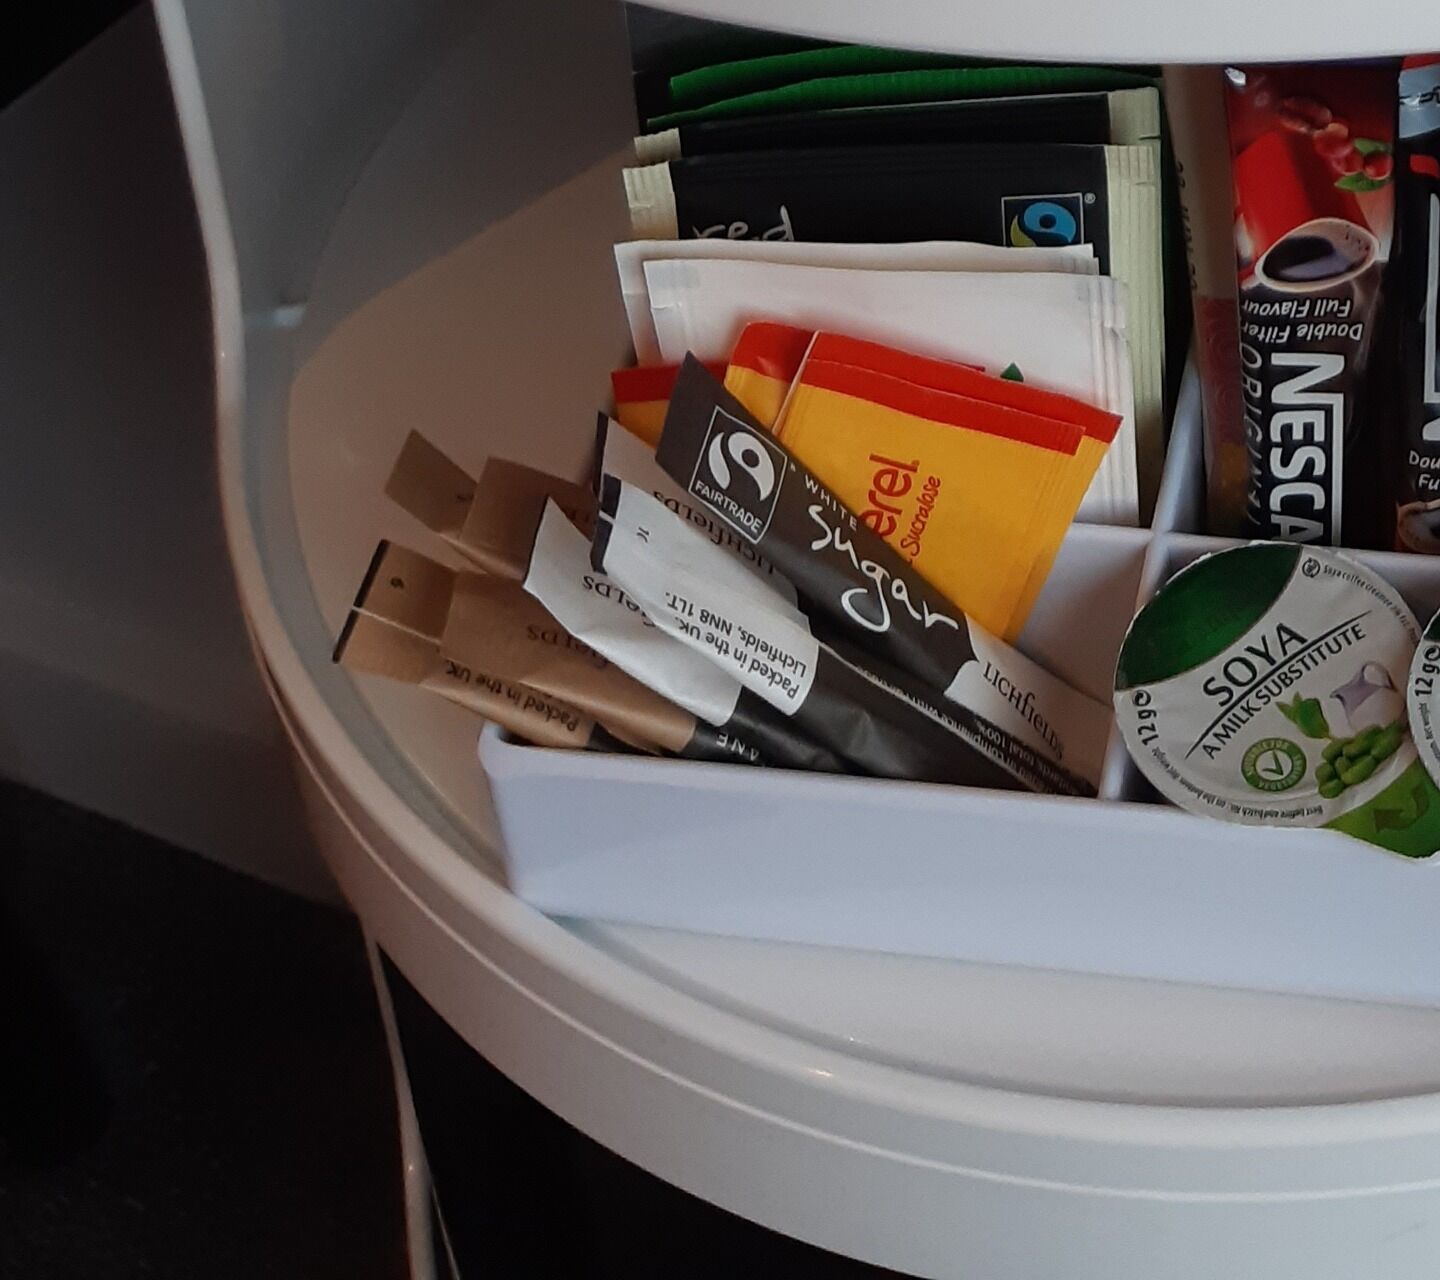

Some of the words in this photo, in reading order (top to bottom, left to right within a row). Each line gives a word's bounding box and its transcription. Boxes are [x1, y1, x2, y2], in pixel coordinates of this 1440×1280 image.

[1314, 298, 1352, 318] Full
[1297, 322, 1364, 342] Double
[1268, 351, 1346, 545] NESCA
[694, 480, 764, 535] FAIRTRADE
[804, 474, 860, 532] WHITE
[900, 475, 942, 557] Sucralose
[674, 616, 702, 640] UK.
[698, 608, 734, 637] NN8
[704, 632, 731, 656] the
[732, 650, 749, 670] in
[736, 625, 809, 679] Lichfields,
[475, 673, 502, 696] the
[749, 659, 801, 700] Packed
[1202, 622, 1310, 707] SOYA
[506, 685, 521, 704] in
[1202, 744, 1221, 760] A
[1213, 700, 1262, 751] MILK
[1258, 622, 1367, 706] SUBSTITUTE
[524, 693, 581, 733] Packed
